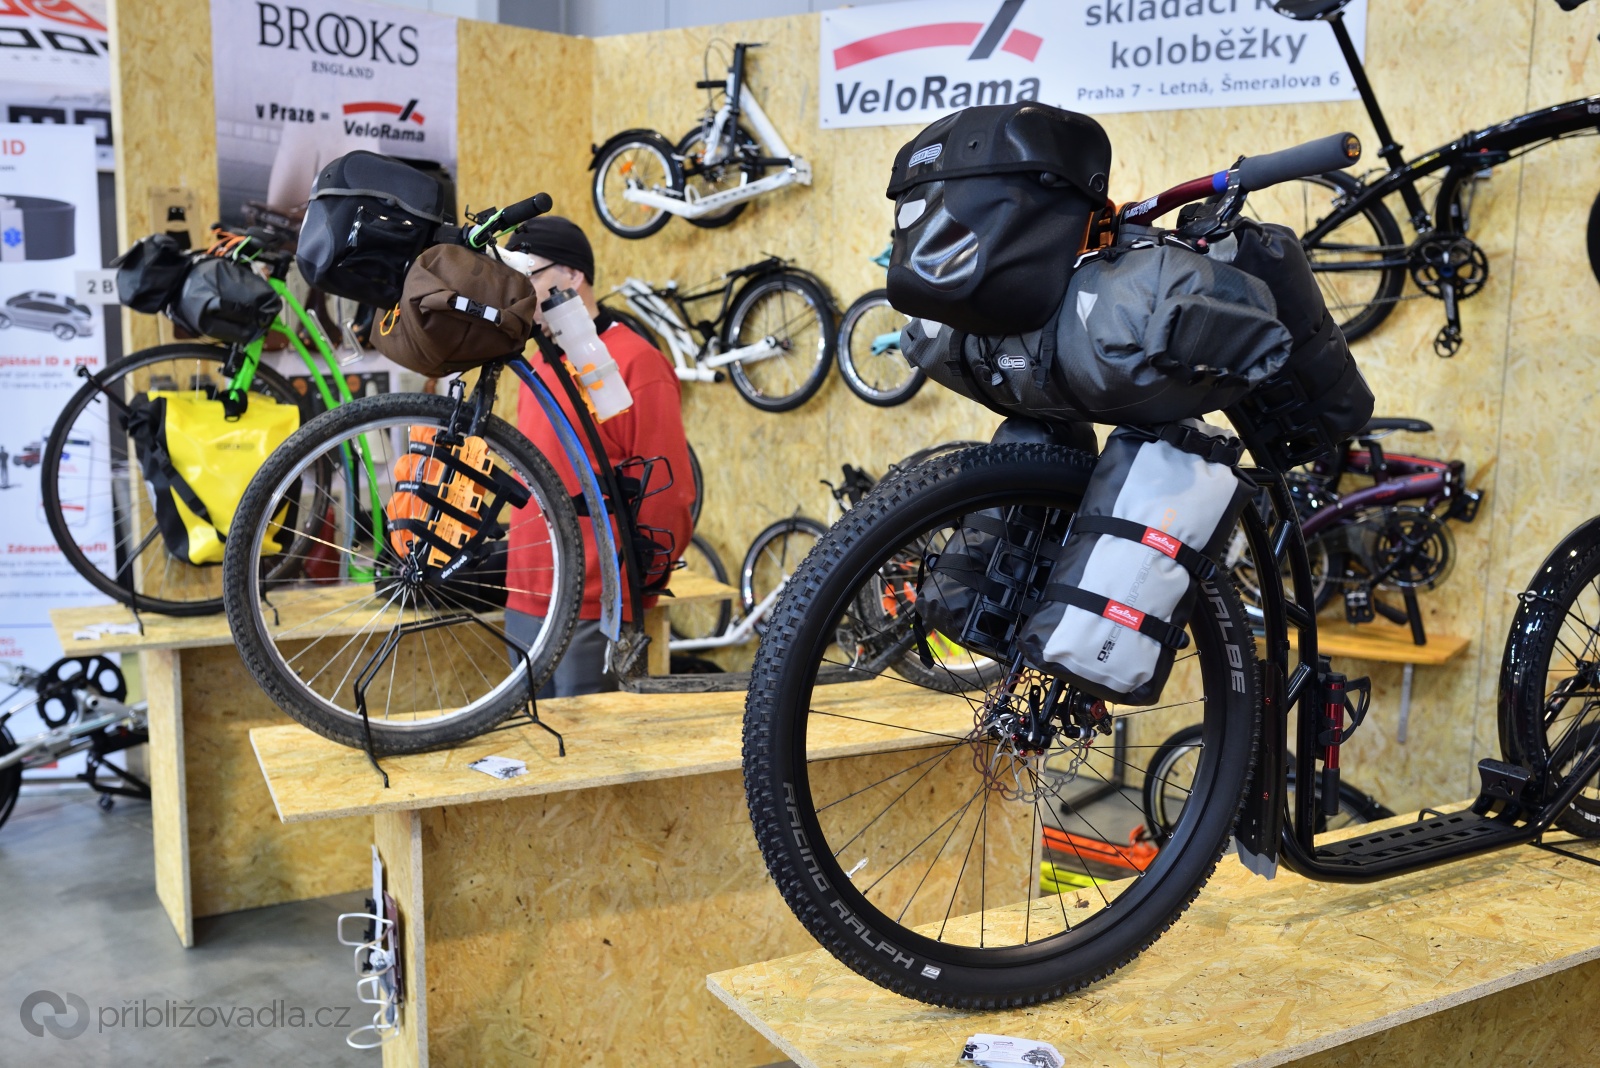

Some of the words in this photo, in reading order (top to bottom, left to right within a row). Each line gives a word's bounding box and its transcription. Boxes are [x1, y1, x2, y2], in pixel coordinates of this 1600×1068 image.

[256, 1, 419, 67] BROOKS
[1111, 27, 1307, 69] koloběžky
[311, 60, 375, 80] ENGLAND
[836, 75, 1041, 115] VeloRama
[1077, 87, 1125, 101] Praha
[1131, 84, 1141, 98] 7
[1160, 78, 1214, 96] Letná,
[1221, 74, 1321, 93] Šmeralova
[1329, 72, 1340, 87] 6
[270, 102, 315, 123] Praze
[344, 120, 426, 142] VeloRama
[3, 140, 26, 155] ID
[87, 280, 97, 294] 2
[1146, 532, 1176, 551] Salsa
[1109, 605, 1138, 624] Salsa
[782, 782, 831, 893] RACING
[829, 899, 915, 970] RALPH
